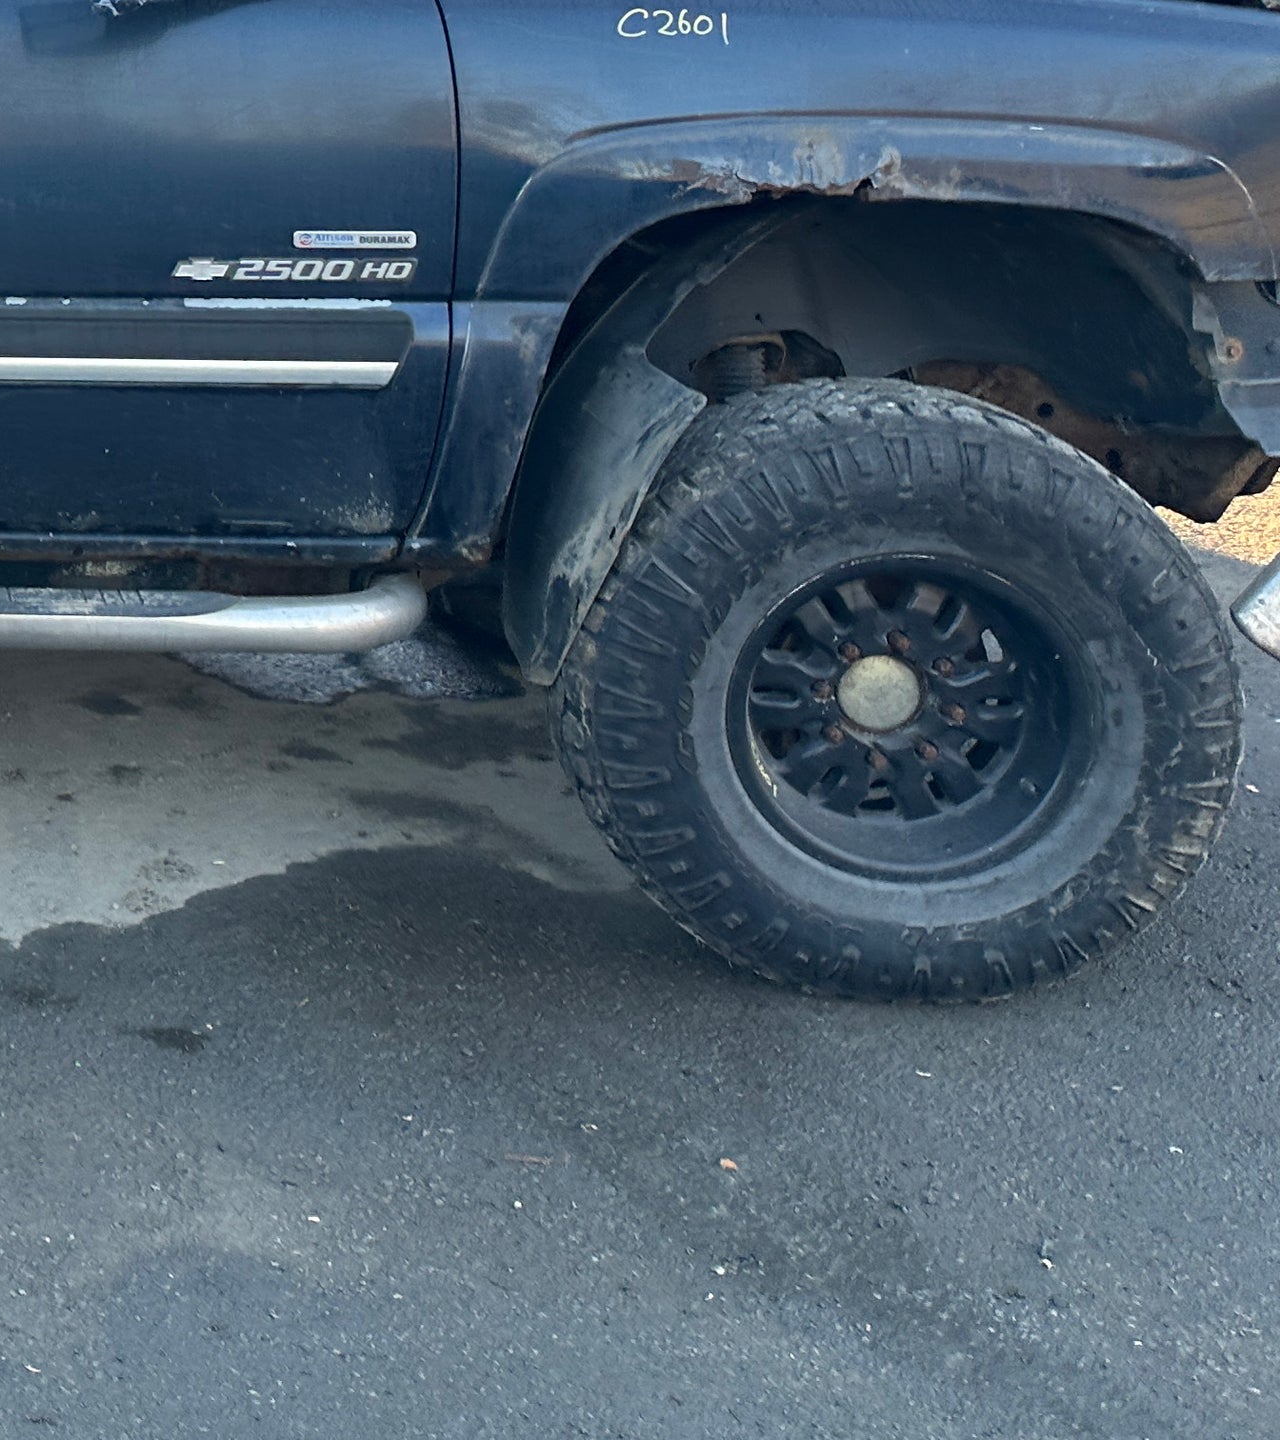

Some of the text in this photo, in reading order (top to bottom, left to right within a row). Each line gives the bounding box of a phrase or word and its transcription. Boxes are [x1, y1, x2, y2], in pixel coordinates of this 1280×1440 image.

[617, 8, 729, 45] C2601
[359, 235, 410, 244] DURAMAX
[233, 260, 412, 280] 2500 HD
